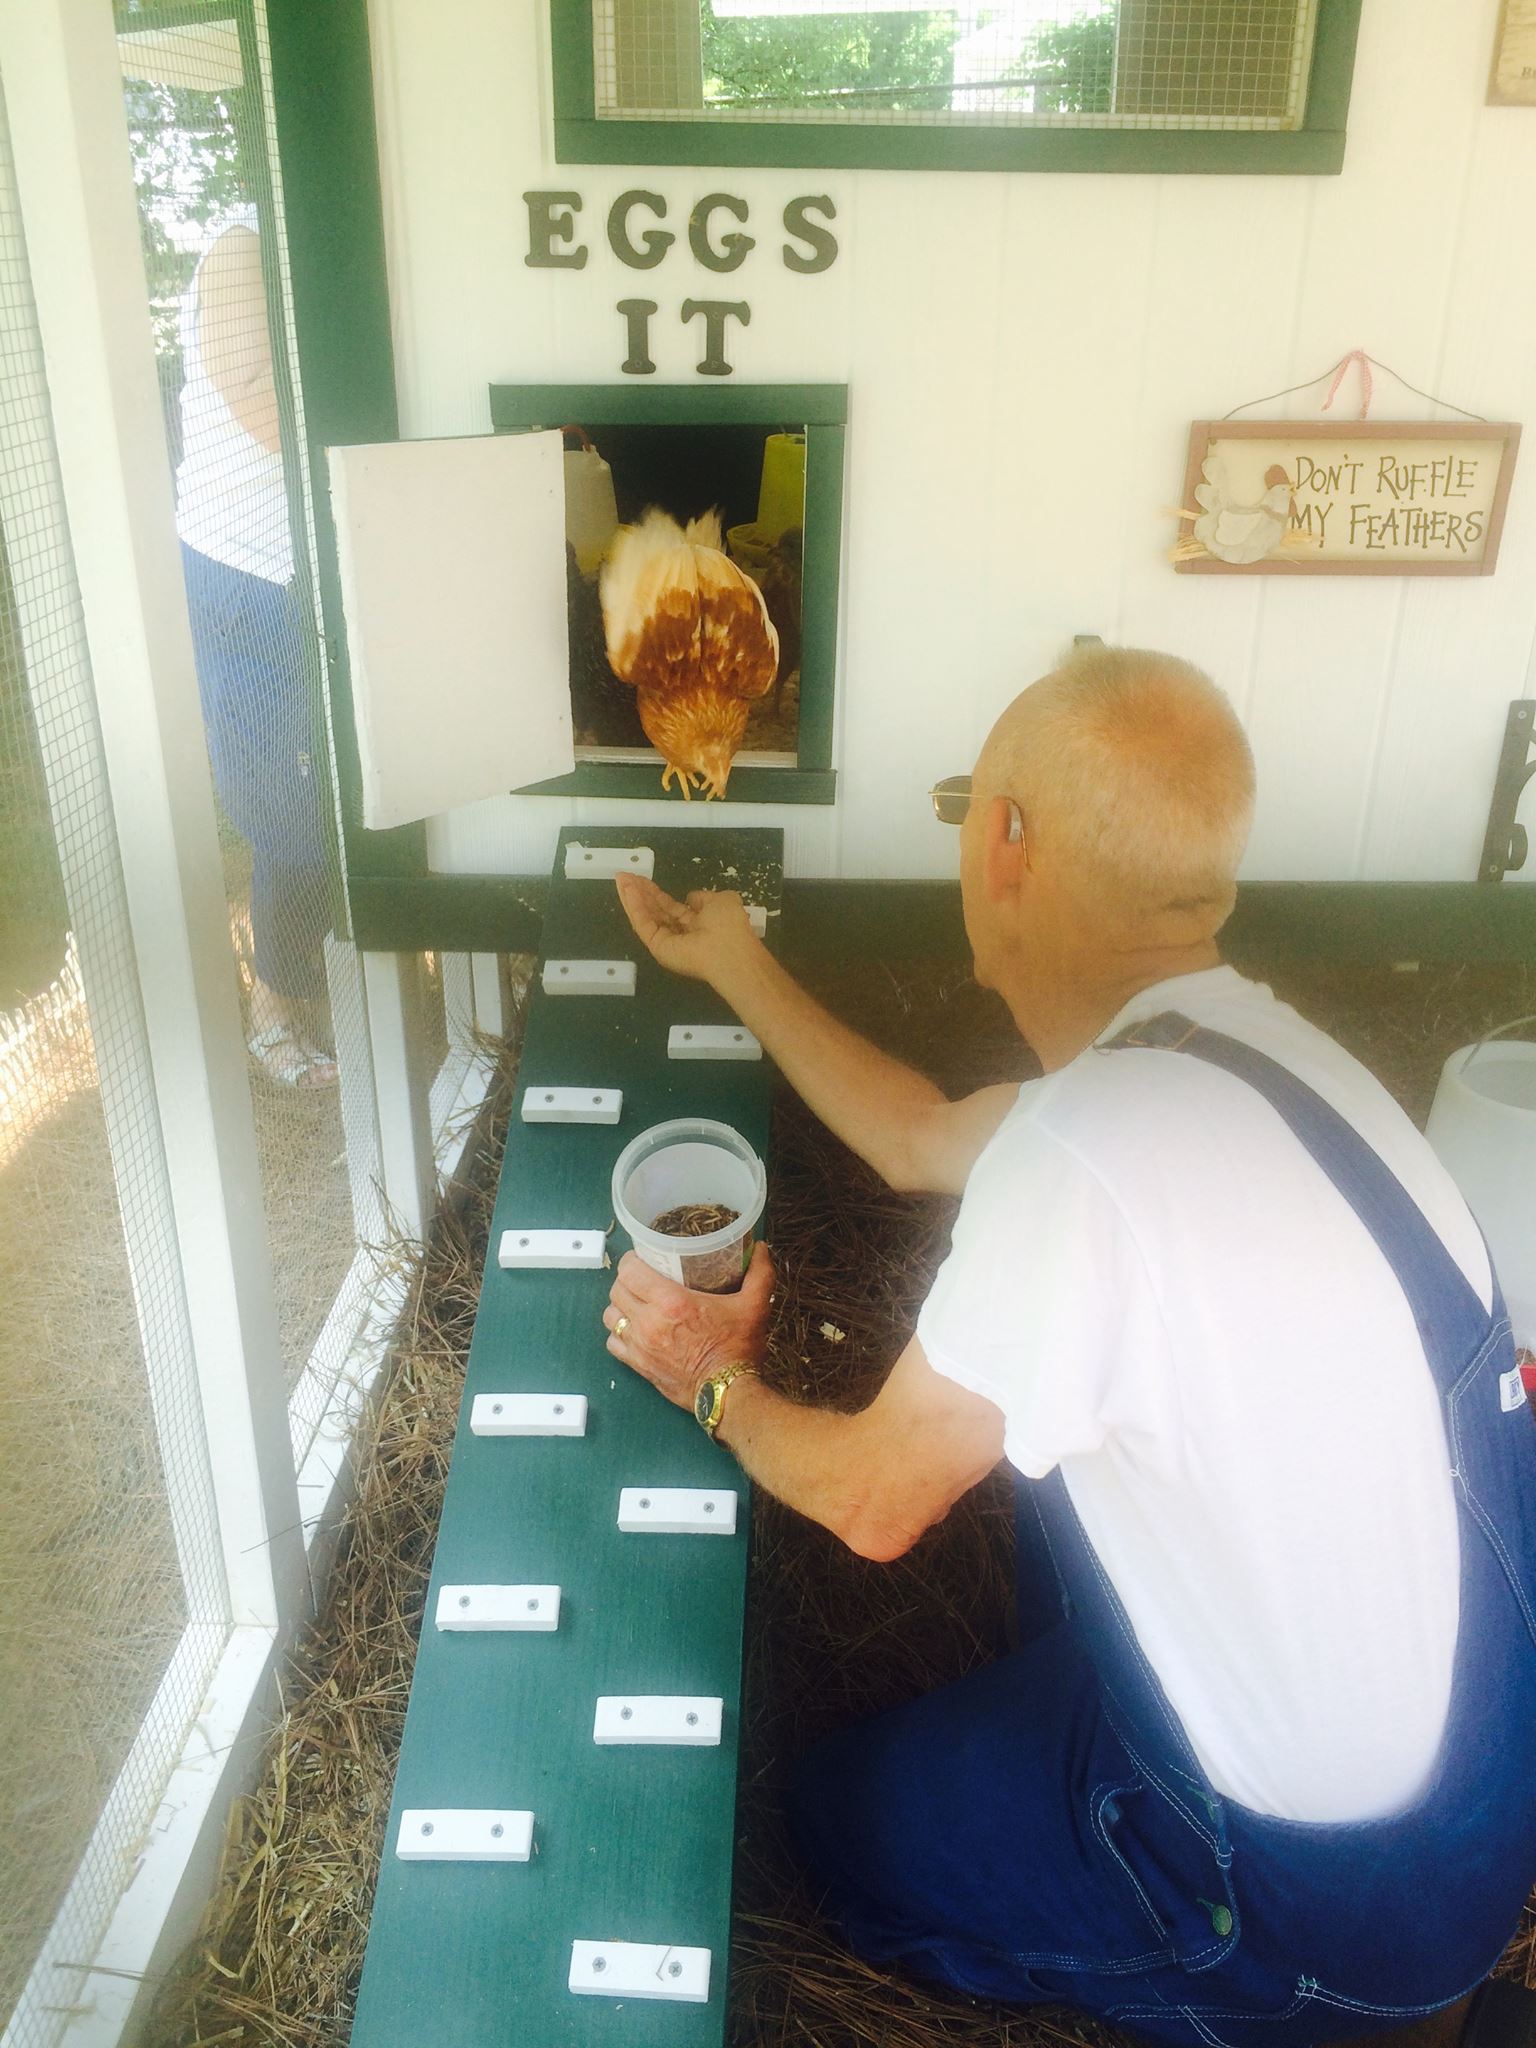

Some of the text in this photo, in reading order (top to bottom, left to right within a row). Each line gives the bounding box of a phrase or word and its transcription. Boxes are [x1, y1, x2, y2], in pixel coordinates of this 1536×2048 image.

[522, 190, 838, 274] EGGS
[616, 298, 751, 376] IT
[1295, 453, 1479, 500] DON'T RUFFLE
[1291, 502, 1484, 553] MY FEATHERS
